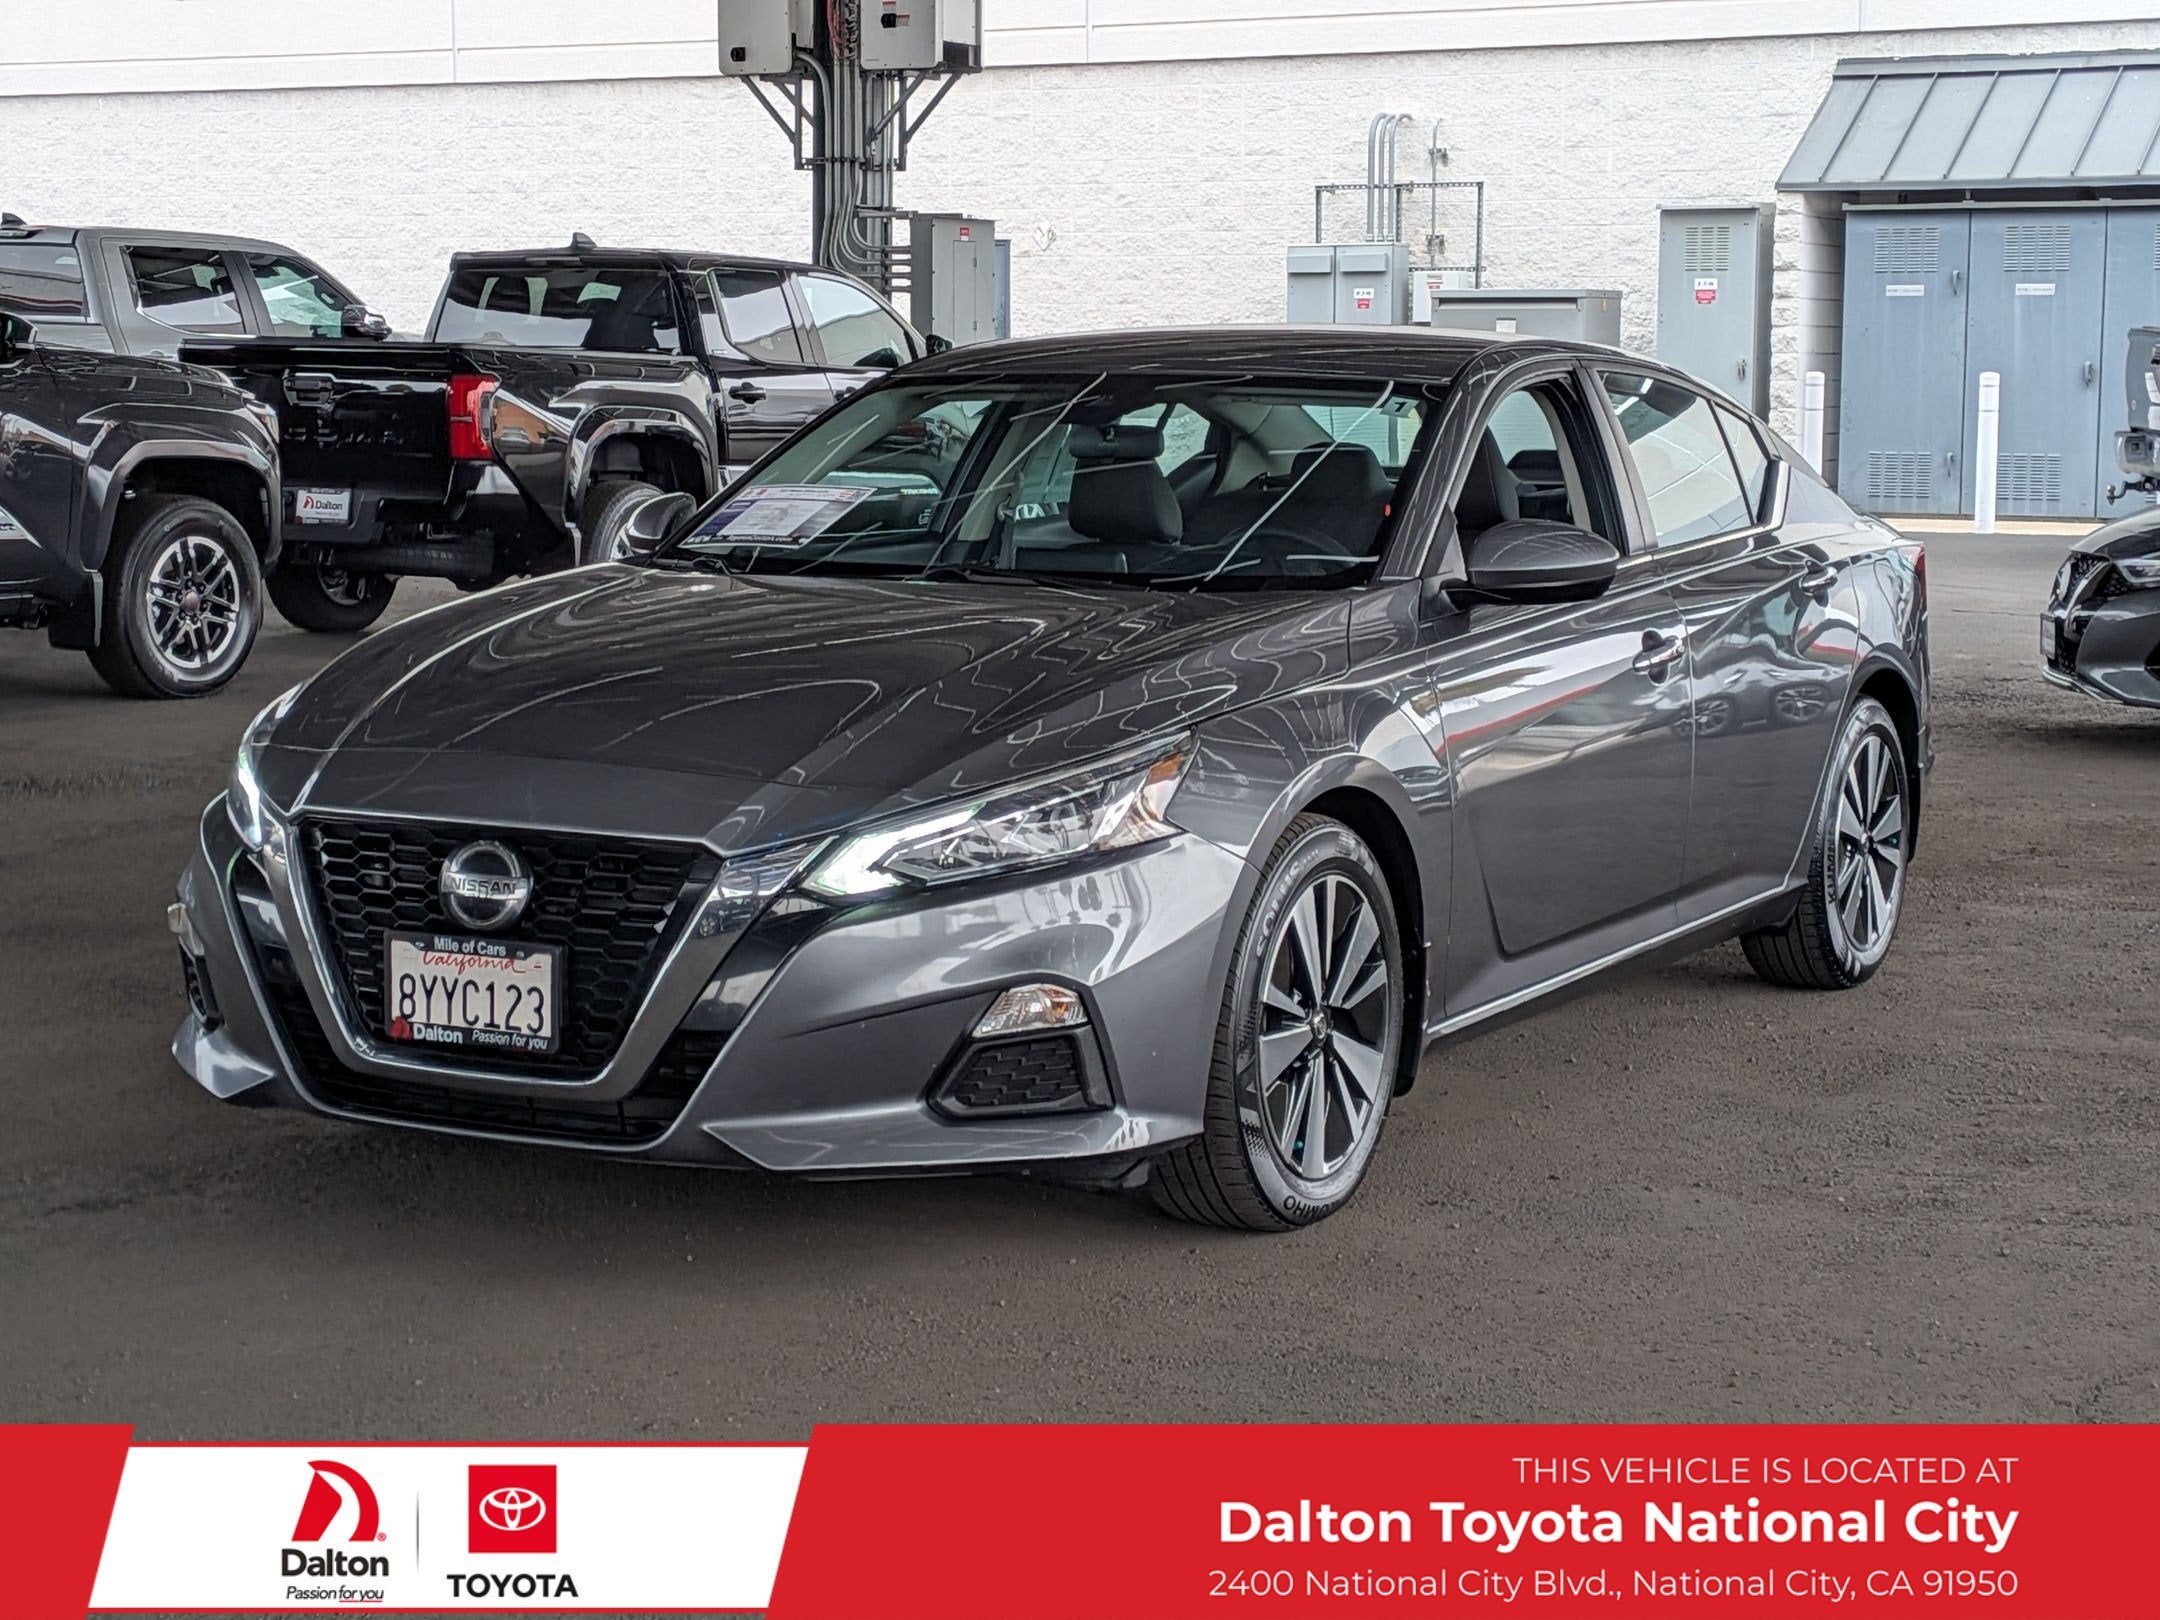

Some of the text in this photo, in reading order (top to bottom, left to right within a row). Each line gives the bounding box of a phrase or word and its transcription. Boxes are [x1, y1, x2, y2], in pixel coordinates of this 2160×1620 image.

[315, 500, 343, 511] Dalton
[451, 877, 517, 895] NISSAN
[434, 936, 507, 956] Mile of Cars
[399, 972, 545, 1034] 8YYC123
[413, 1022, 464, 1045] Dalton
[472, 1029, 549, 1050] Passion for you
